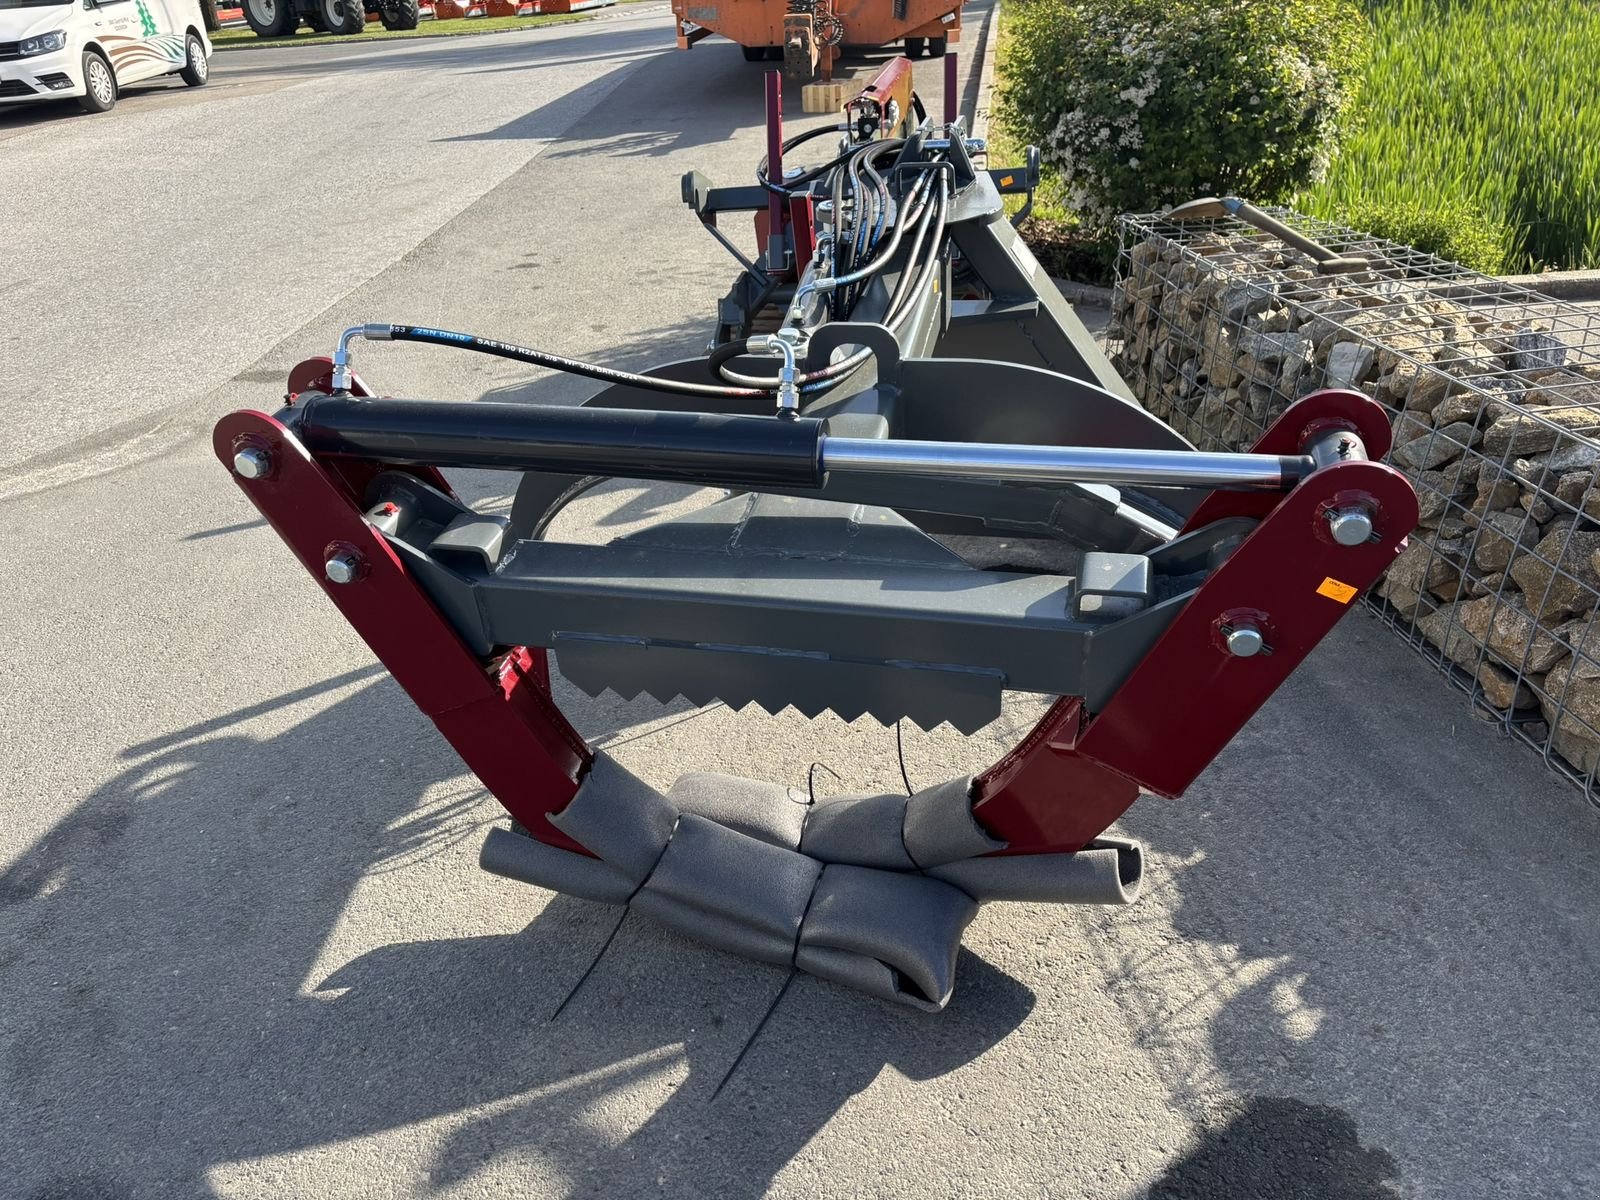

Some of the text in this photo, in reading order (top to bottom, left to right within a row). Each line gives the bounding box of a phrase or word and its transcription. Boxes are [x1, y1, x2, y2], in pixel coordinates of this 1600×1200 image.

[417, 327, 437, 336] 2SN
[439, 330, 465, 341] DN10
[476, 338, 497, 348] SAE
[500, 343, 516, 352] 100
[518, 347, 542, 359] R2AT
